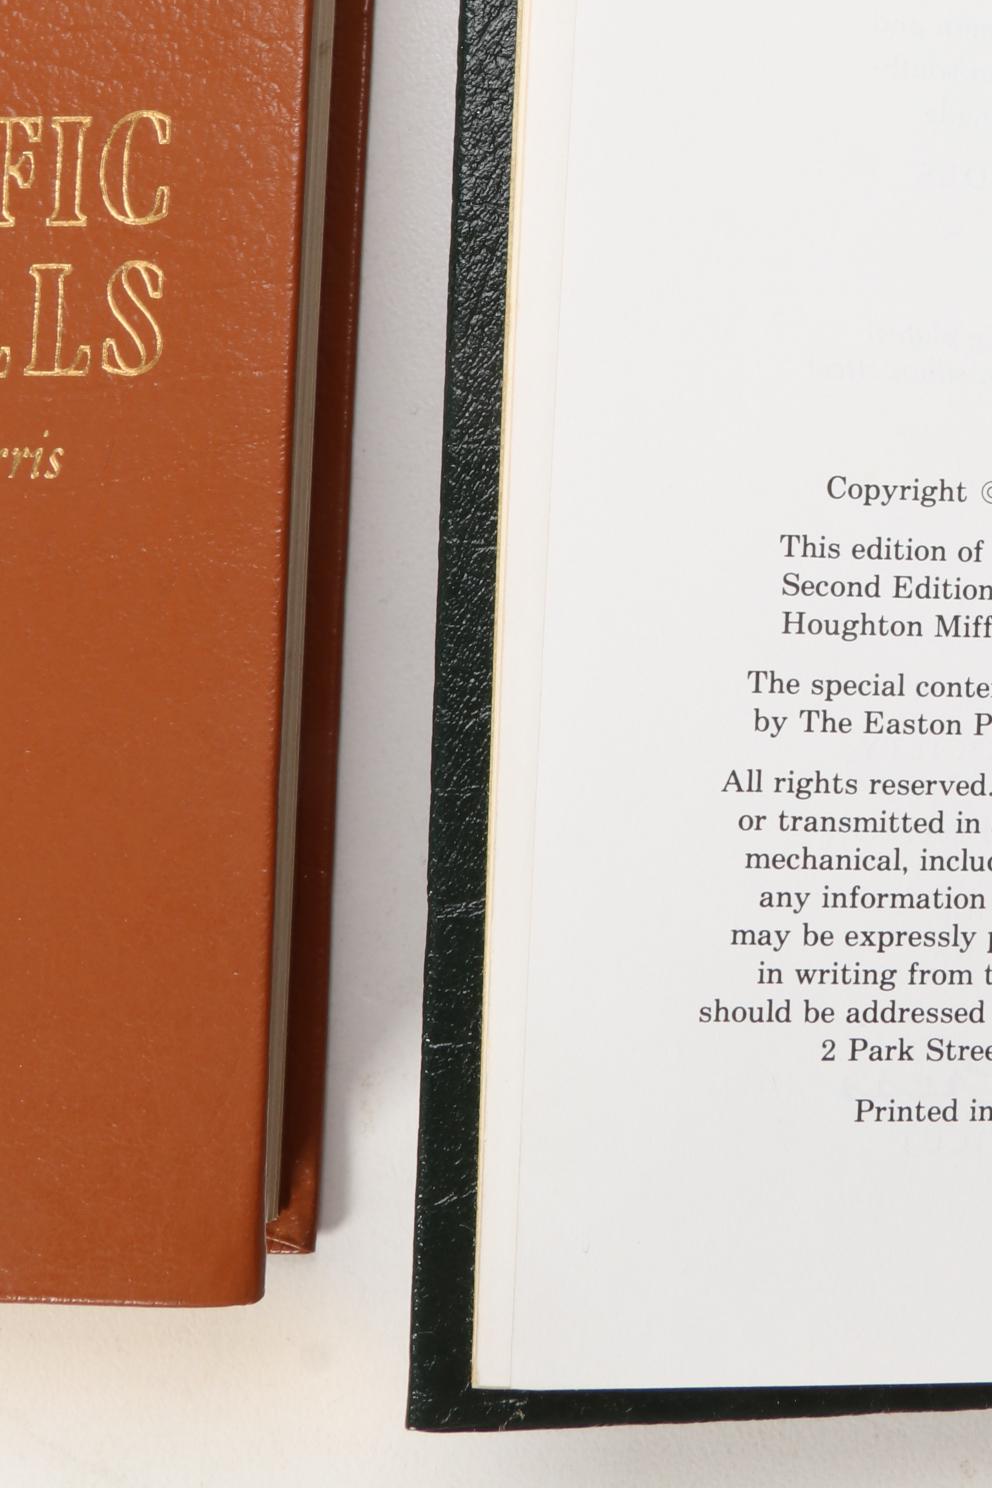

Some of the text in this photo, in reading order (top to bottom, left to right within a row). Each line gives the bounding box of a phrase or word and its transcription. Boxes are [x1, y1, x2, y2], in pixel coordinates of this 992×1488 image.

[0, 260, 164, 378] LS
[826, 475, 968, 508] Copyright
[779, 533, 841, 560] This
[851, 535, 947, 562] edition
[957, 539, 985, 563] of
[781, 571, 882, 599] Second
[781, 610, 924, 643] Houghton
[746, 669, 801, 696] The
[810, 672, 906, 703] special
[753, 707, 789, 739] by
[798, 708, 853, 735] The
[862, 710, 963, 736] Easton
[720, 768, 764, 793] All
[773, 769, 858, 801] rights
[737, 814, 768, 832] or
[778, 809, 945, 835] transmitted
[954, 810, 982, 835] in
[744, 845, 908, 876] mechanical,
[759, 890, 812, 915] any
[821, 884, 987, 910] information
[730, 928, 792, 953] may
[801, 921, 835, 948] be
[844, 922, 978, 954] expressly
[756, 960, 784, 985] in
[794, 961, 898, 992] writing
[907, 961, 974, 986] from
[698, 997, 793, 1024] should
[802, 998, 836, 1024] be
[845, 999, 986, 1025] addressed
[820, 1038, 837, 1062] 2
[847, 1036, 915, 1063] Park
[853, 1097, 959, 1123] Printed
